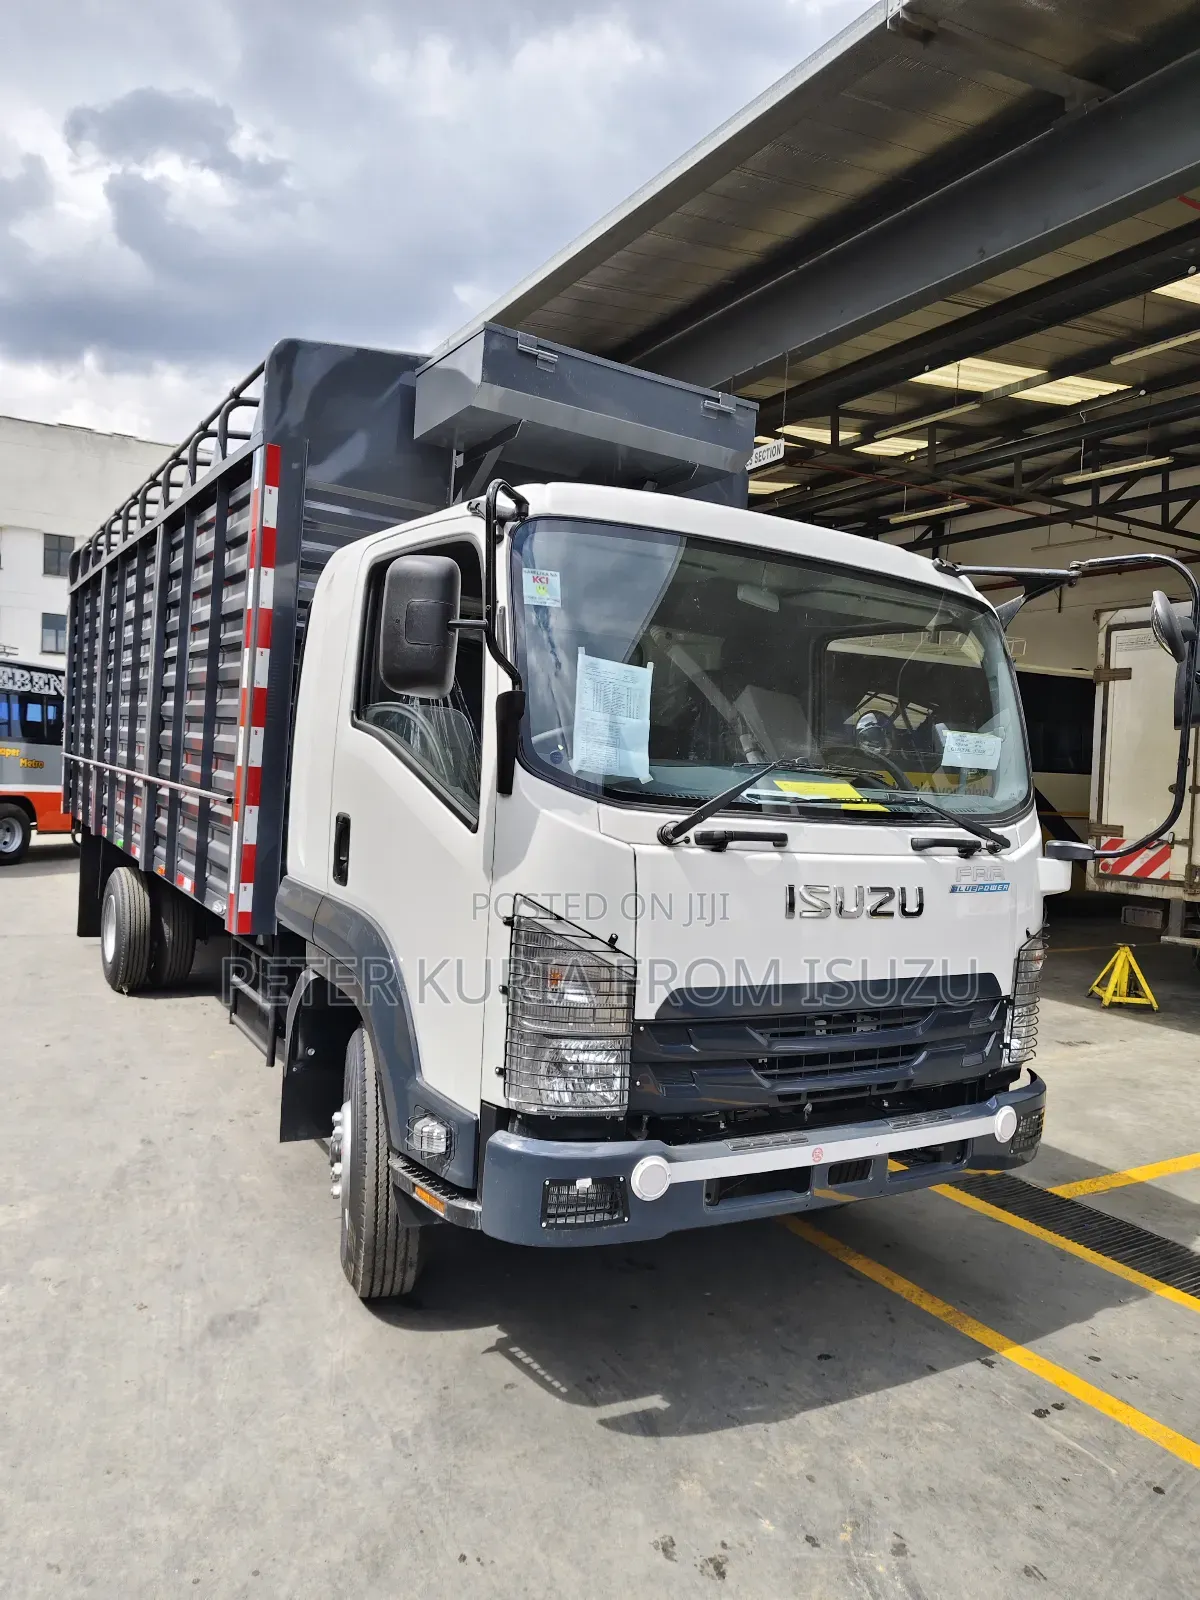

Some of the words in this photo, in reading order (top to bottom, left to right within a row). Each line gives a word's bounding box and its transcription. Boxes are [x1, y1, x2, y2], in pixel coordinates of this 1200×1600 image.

[754, 443, 781, 463] SECTION
[532, 575, 548, 584] KCI
[19, 758, 45, 769] Metro
[785, 884, 925, 919] ISUZU
